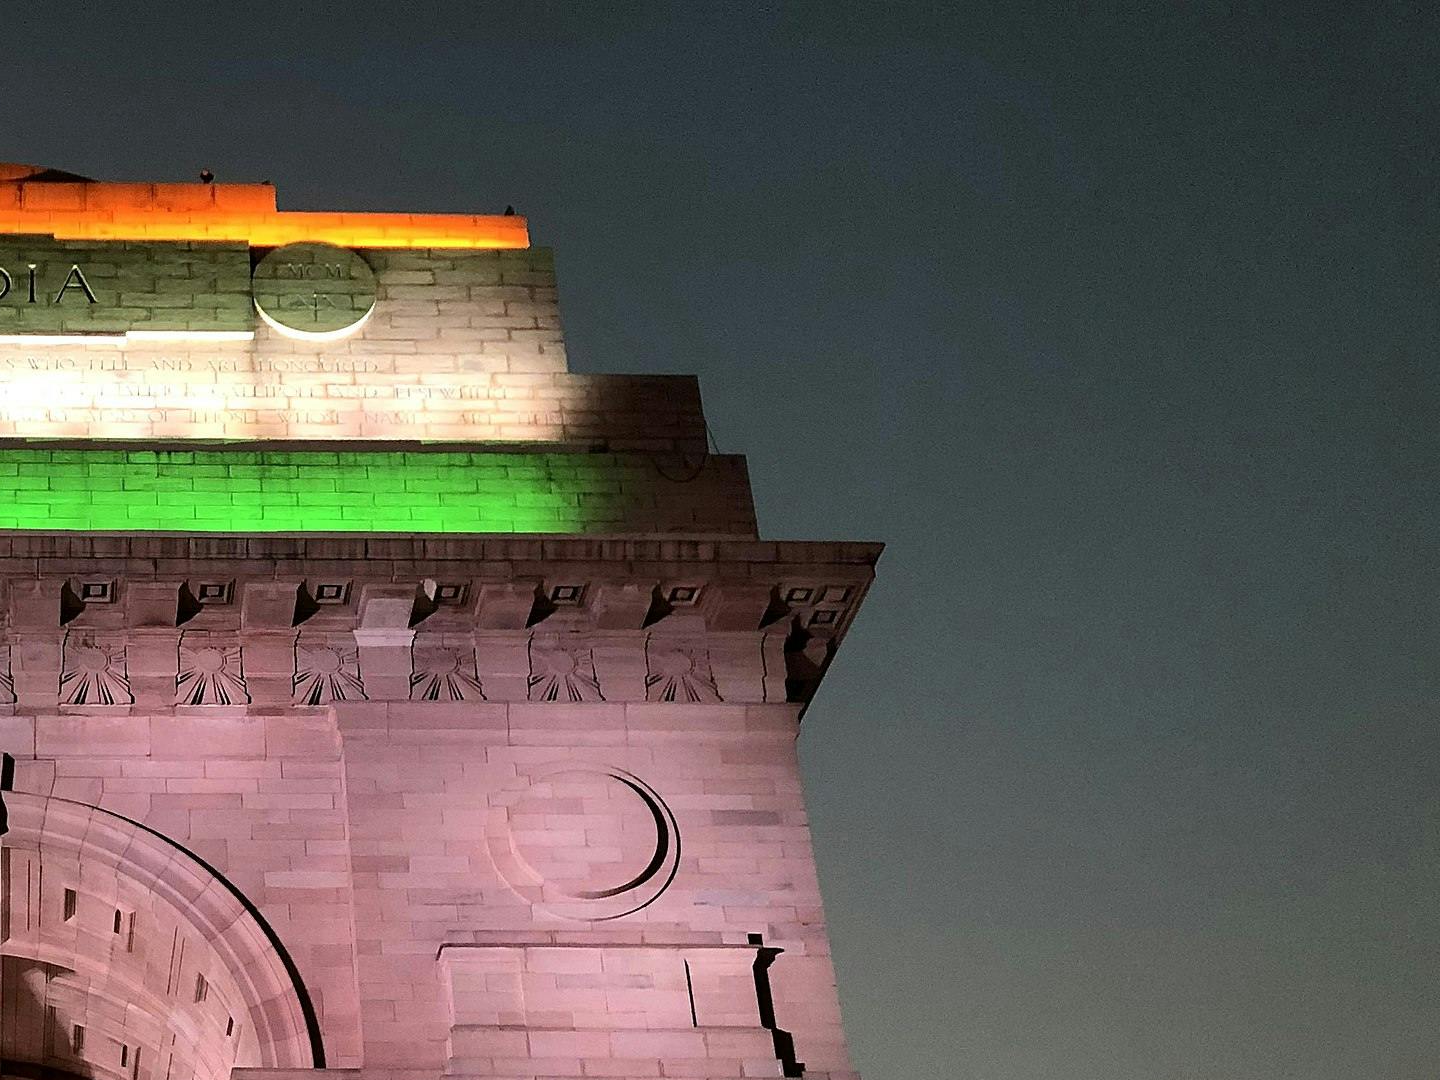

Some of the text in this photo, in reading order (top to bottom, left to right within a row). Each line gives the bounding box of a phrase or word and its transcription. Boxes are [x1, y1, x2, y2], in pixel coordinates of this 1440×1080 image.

[27, 356, 76, 371] WHO
[89, 357, 131, 372] FELL
[150, 358, 193, 372] AND
[207, 358, 239, 372] ARE
[258, 357, 379, 374] HONOURED
[394, 385, 509, 400] ELSEWHERE
